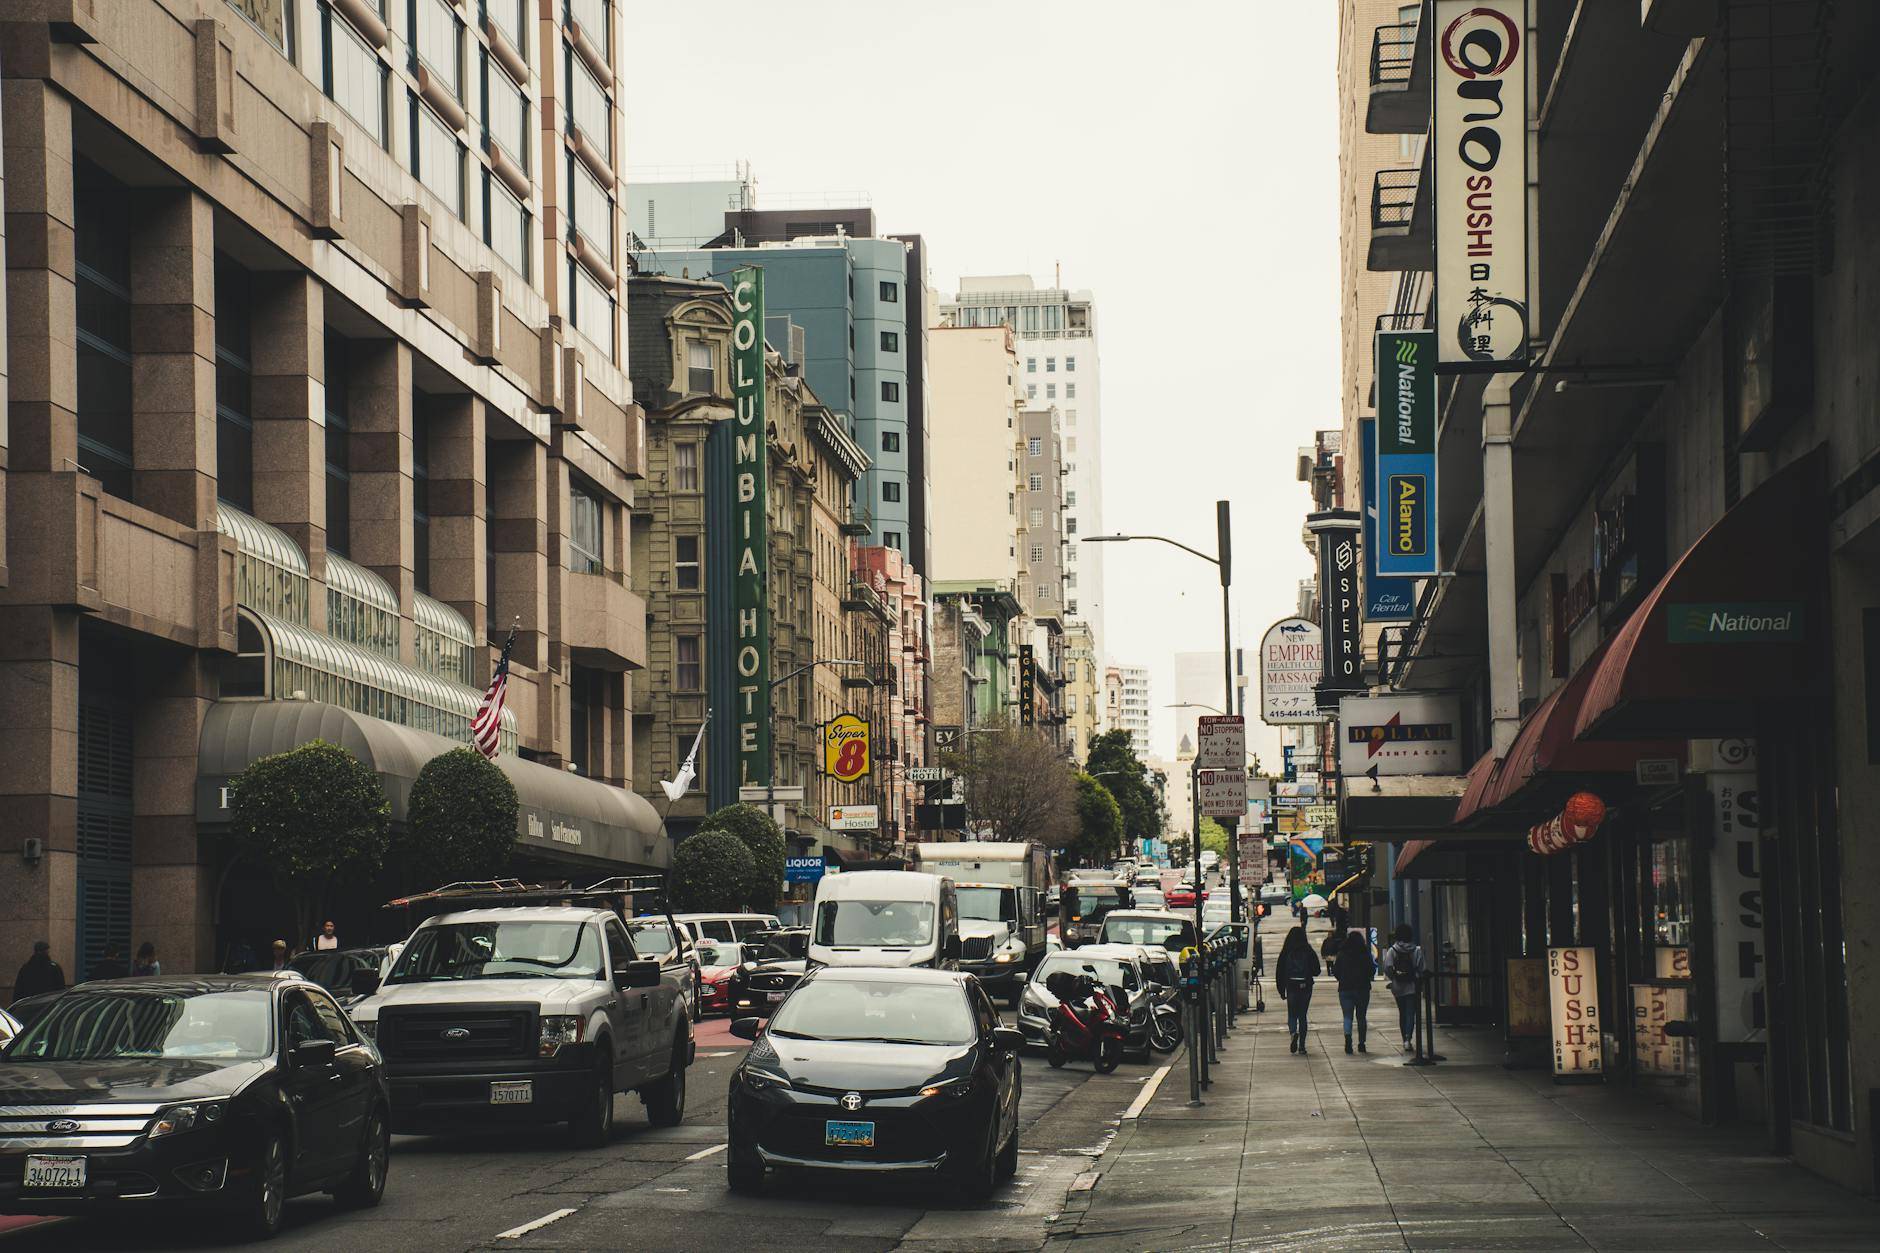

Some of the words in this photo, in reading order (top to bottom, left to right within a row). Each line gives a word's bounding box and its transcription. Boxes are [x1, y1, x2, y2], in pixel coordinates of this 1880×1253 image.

[1466, 175, 1493, 257] SUSHI
[1467, 263, 1494, 353] 日本料理
[1399, 364, 1416, 444] National
[734, 280, 758, 577] COLUMBIA
[1399, 480, 1417, 551] Alamo
[1371, 603, 1410, 613] Rental
[1380, 595, 1400, 603] Car
[1341, 578, 1353, 675] SPERO
[1709, 612, 1791, 632] National
[1267, 661, 1300, 669] HEALTH
[738, 607, 760, 787] HOTEL
[829, 725, 866, 746] Super
[1201, 725, 1213, 735] NO
[1214, 726, 1243, 734] STOPPING
[1355, 727, 1449, 740] DOLLAR
[834, 740, 867, 776] 8
[1202, 774, 1213, 784] NO
[1216, 775, 1244, 784] PARKING
[1204, 800, 1214, 808] MON
[1215, 800, 1225, 808] WED
[1226, 800, 1234, 808] FRI
[844, 818, 874, 828] Hostel
[786, 858, 822, 868] LIQUOR
[1562, 949, 1587, 1071] SUSHI
